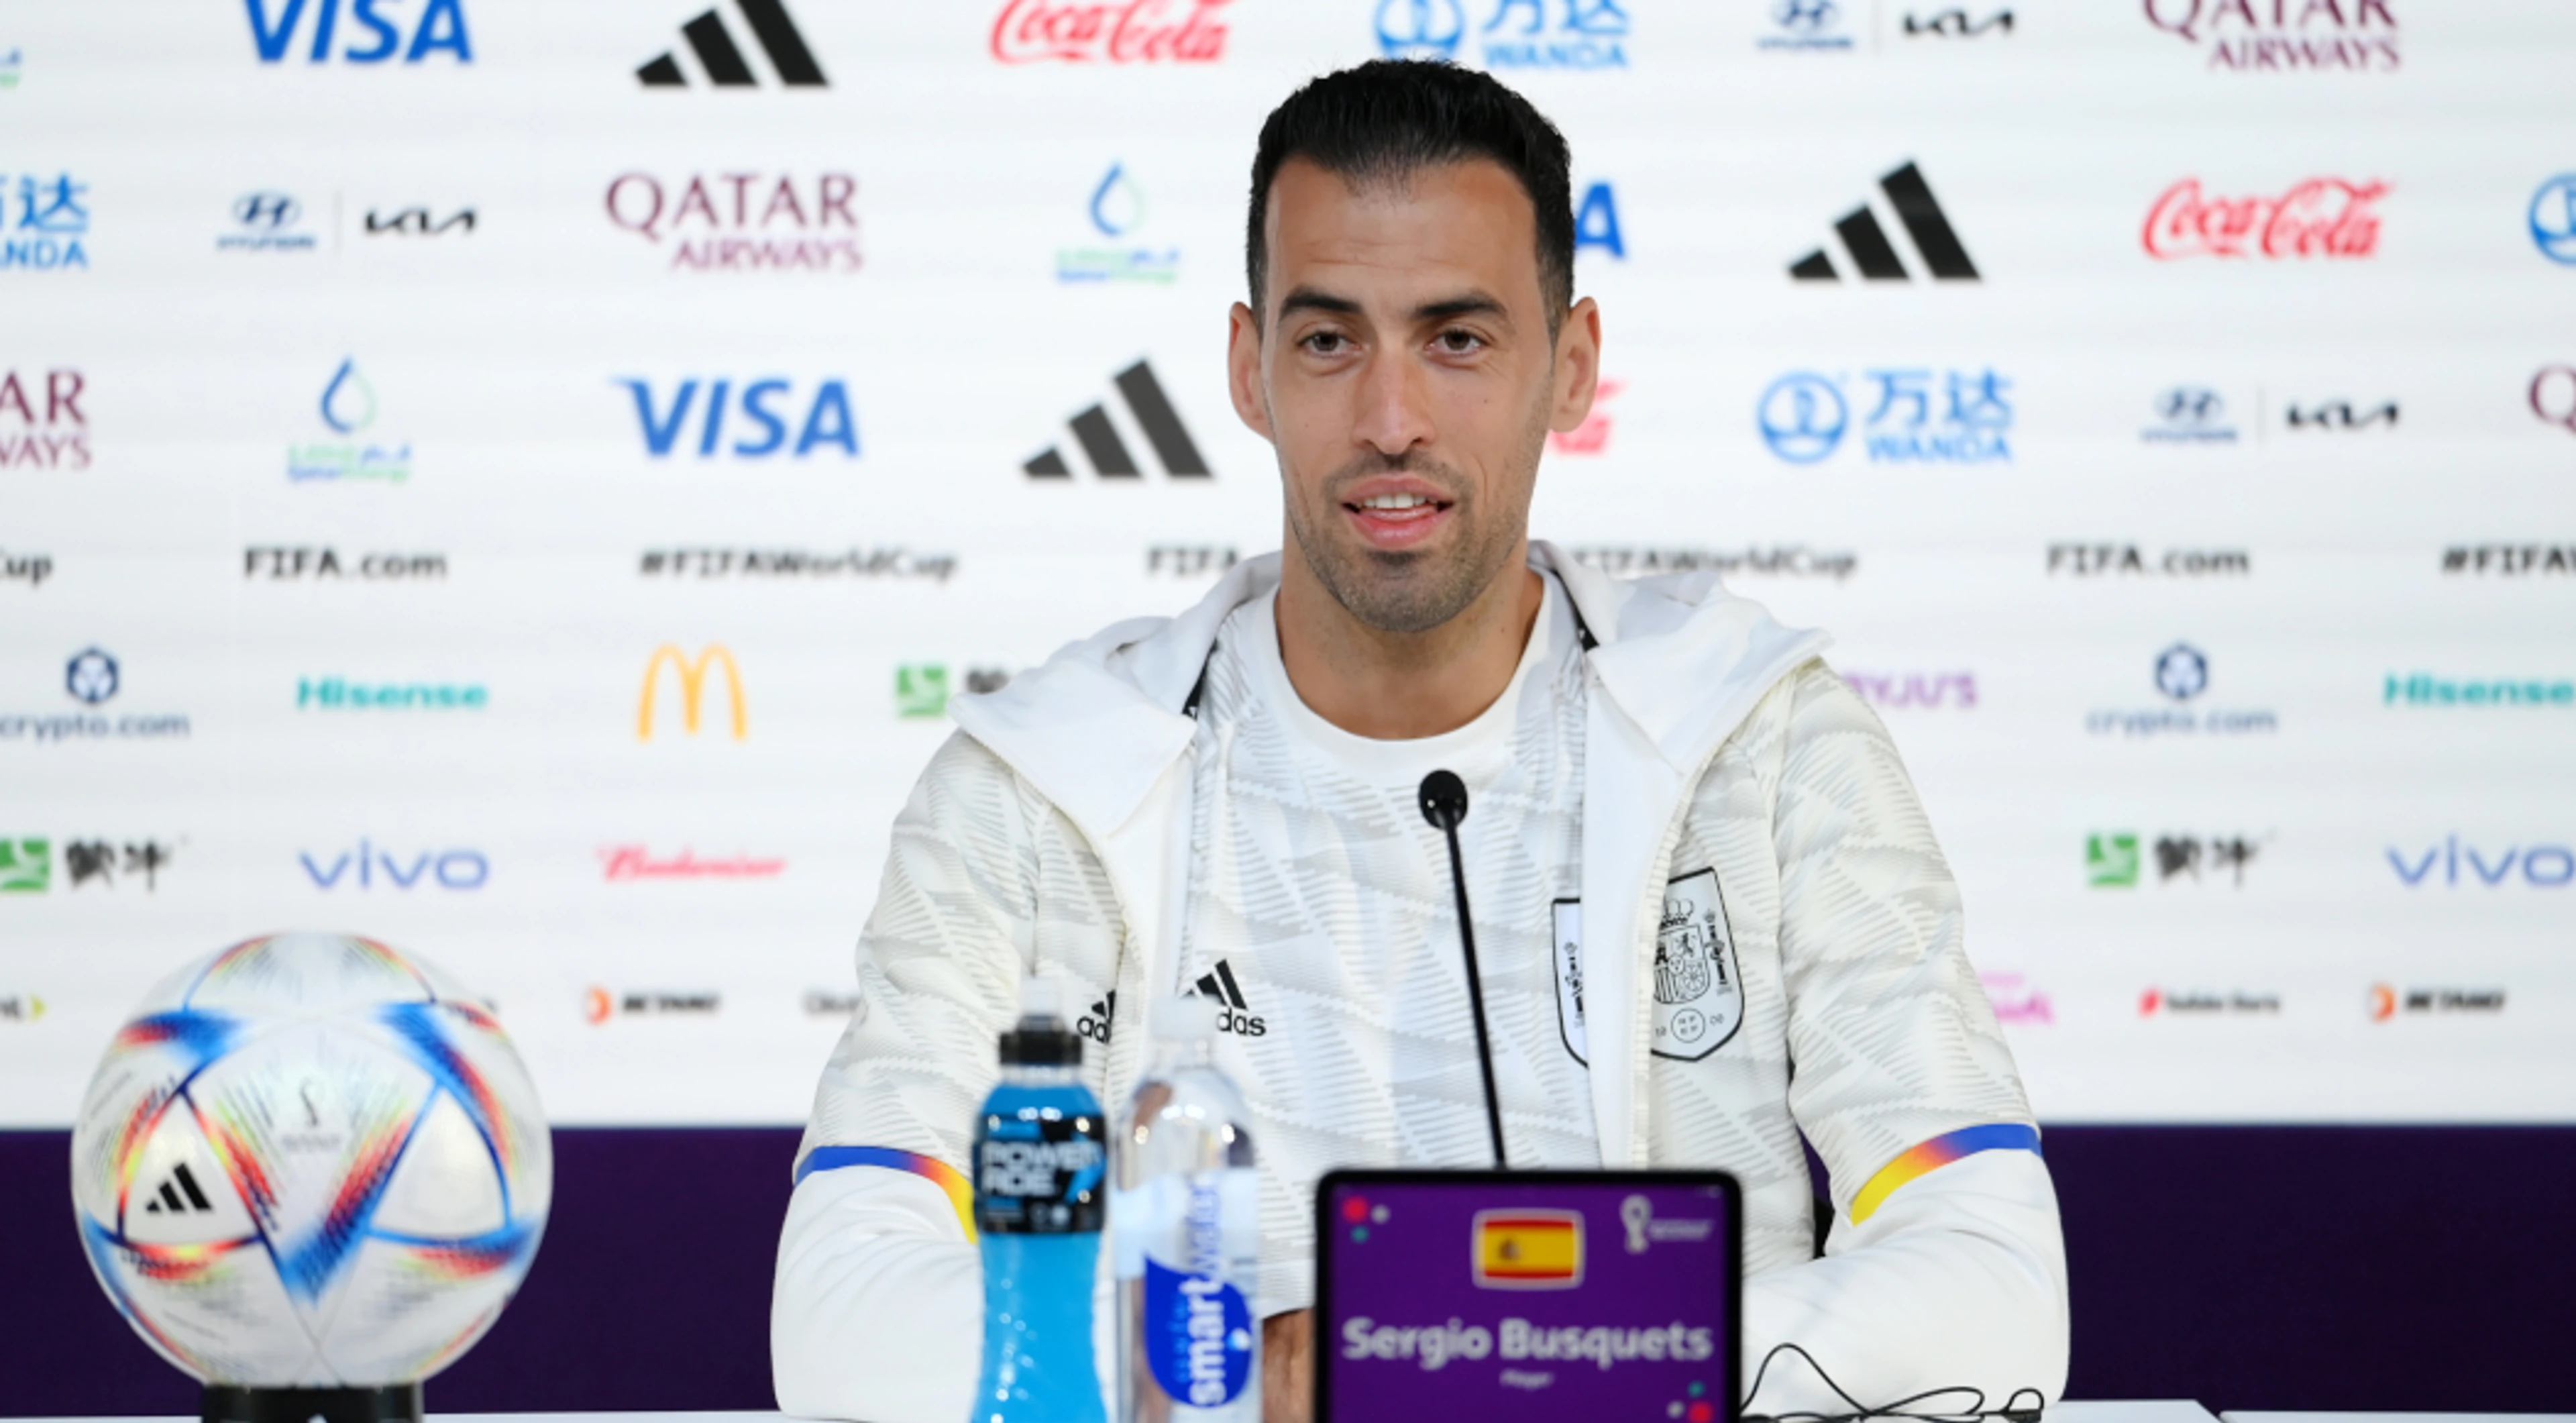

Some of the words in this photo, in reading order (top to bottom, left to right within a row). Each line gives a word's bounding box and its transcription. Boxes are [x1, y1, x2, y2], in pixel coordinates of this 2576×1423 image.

[245, 0, 472, 63] VISA
[1483, 43, 1627, 68] WANDA
[2214, 38, 2400, 68] AIRWAYS
[604, 172, 857, 242] QATAR
[2141, 178, 2391, 259] Coca-Cola
[672, 239, 862, 270] AIRWAYS
[1867, 369, 2012, 428] 万达
[612, 377, 859, 458] VISA
[1867, 436, 2011, 462] WANDA
[244, 547, 446, 579] FIFA.com
[639, 549, 957, 582] #FIFAWorldCup
[2047, 544, 2250, 576] FIFA.com
[2443, 545, 2576, 574] #FIFA
[297, 678, 488, 709] Hisense
[2383, 674, 2576, 706] Hisense
[0, 713, 191, 741] crypto.com
[2086, 708, 2279, 736] crypto.com
[298, 837, 490, 890] vivo
[2385, 834, 2576, 887] vivo
[1217, 1008, 1267, 1037] das
[1342, 1316, 1493, 1371] Sergio
[1499, 1318, 1713, 1371] Busquets
